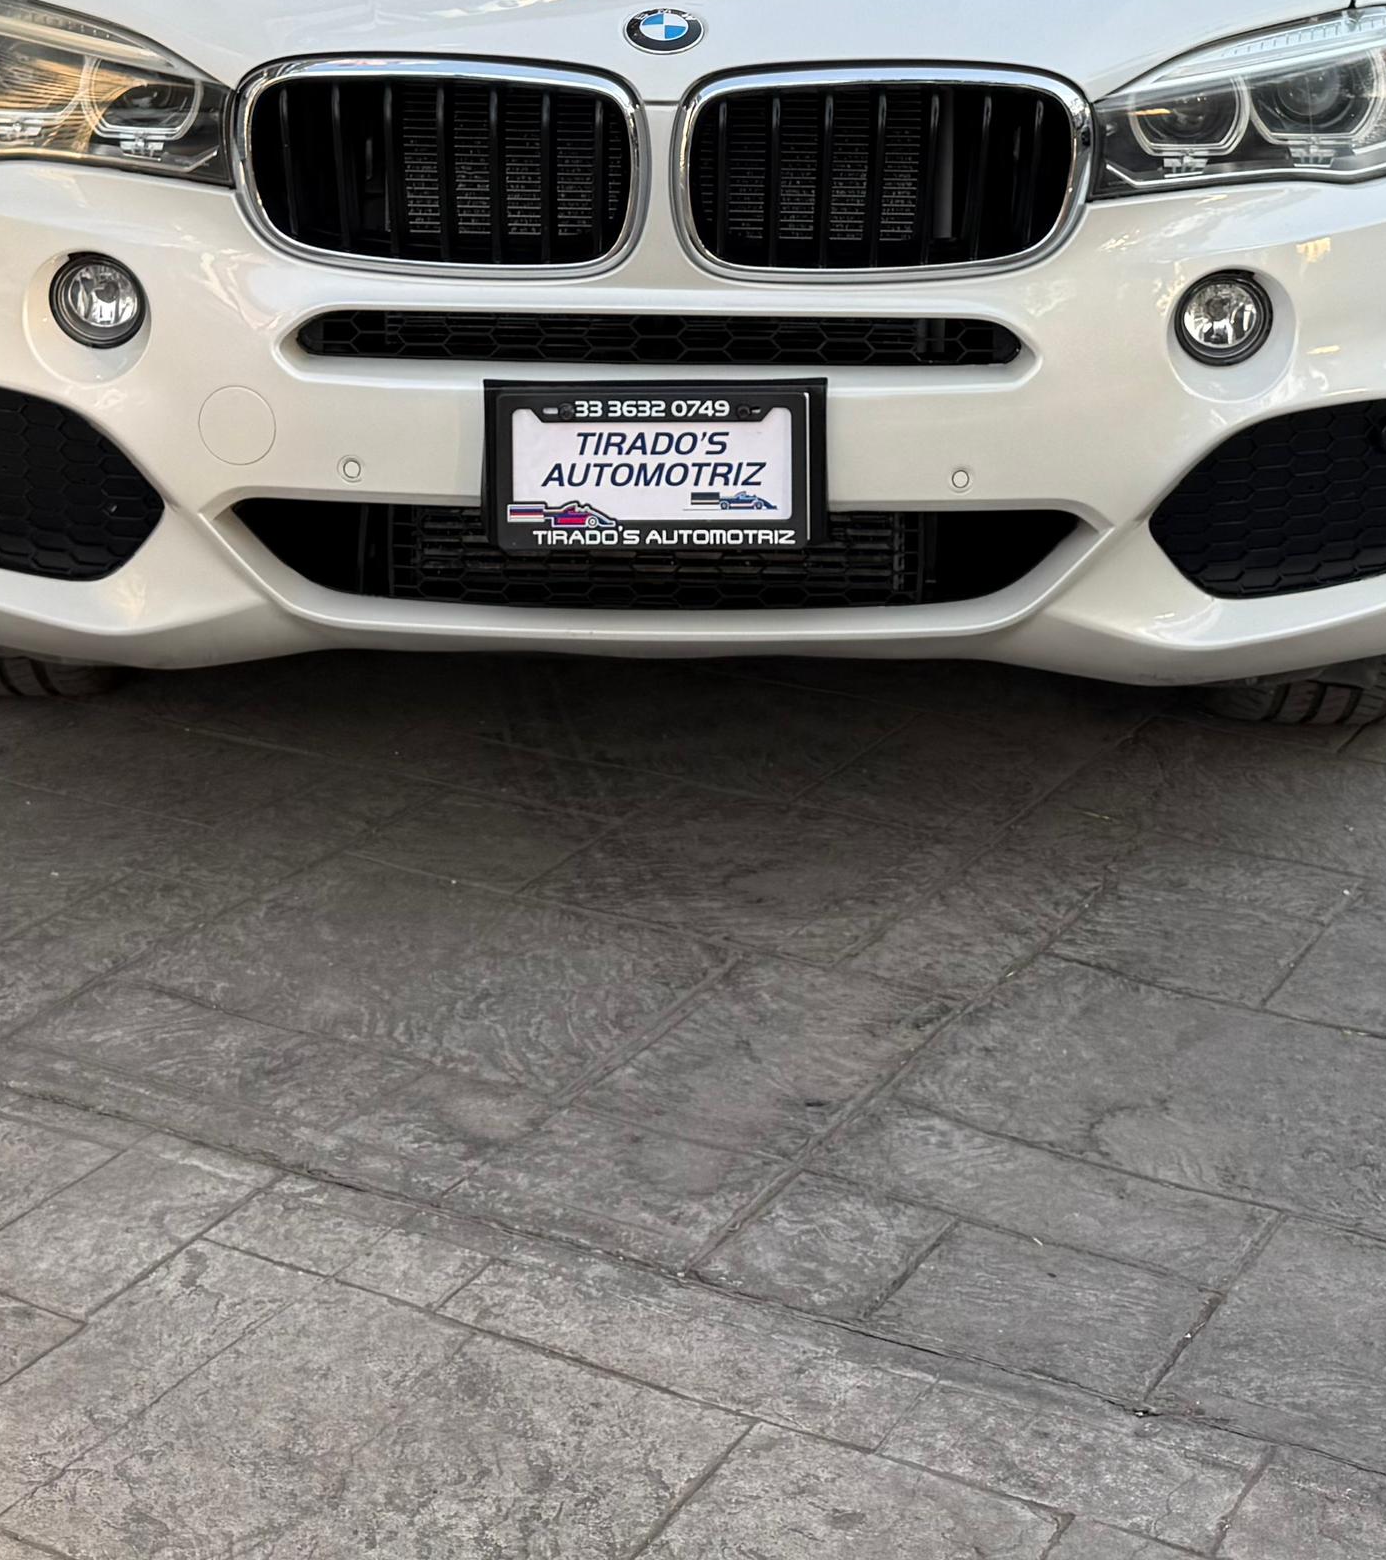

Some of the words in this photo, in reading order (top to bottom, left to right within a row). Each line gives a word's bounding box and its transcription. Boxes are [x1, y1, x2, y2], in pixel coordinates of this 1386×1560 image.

[574, 401, 602, 418] 33
[608, 401, 666, 418] 3632
[670, 400, 730, 418] 0749
[576, 431, 729, 456] TIRADO'S
[541, 462, 766, 487] AUTOMOTRIZ
[533, 526, 640, 545] TIRADO'S
[645, 529, 795, 545] AUTOMOTRIZ
